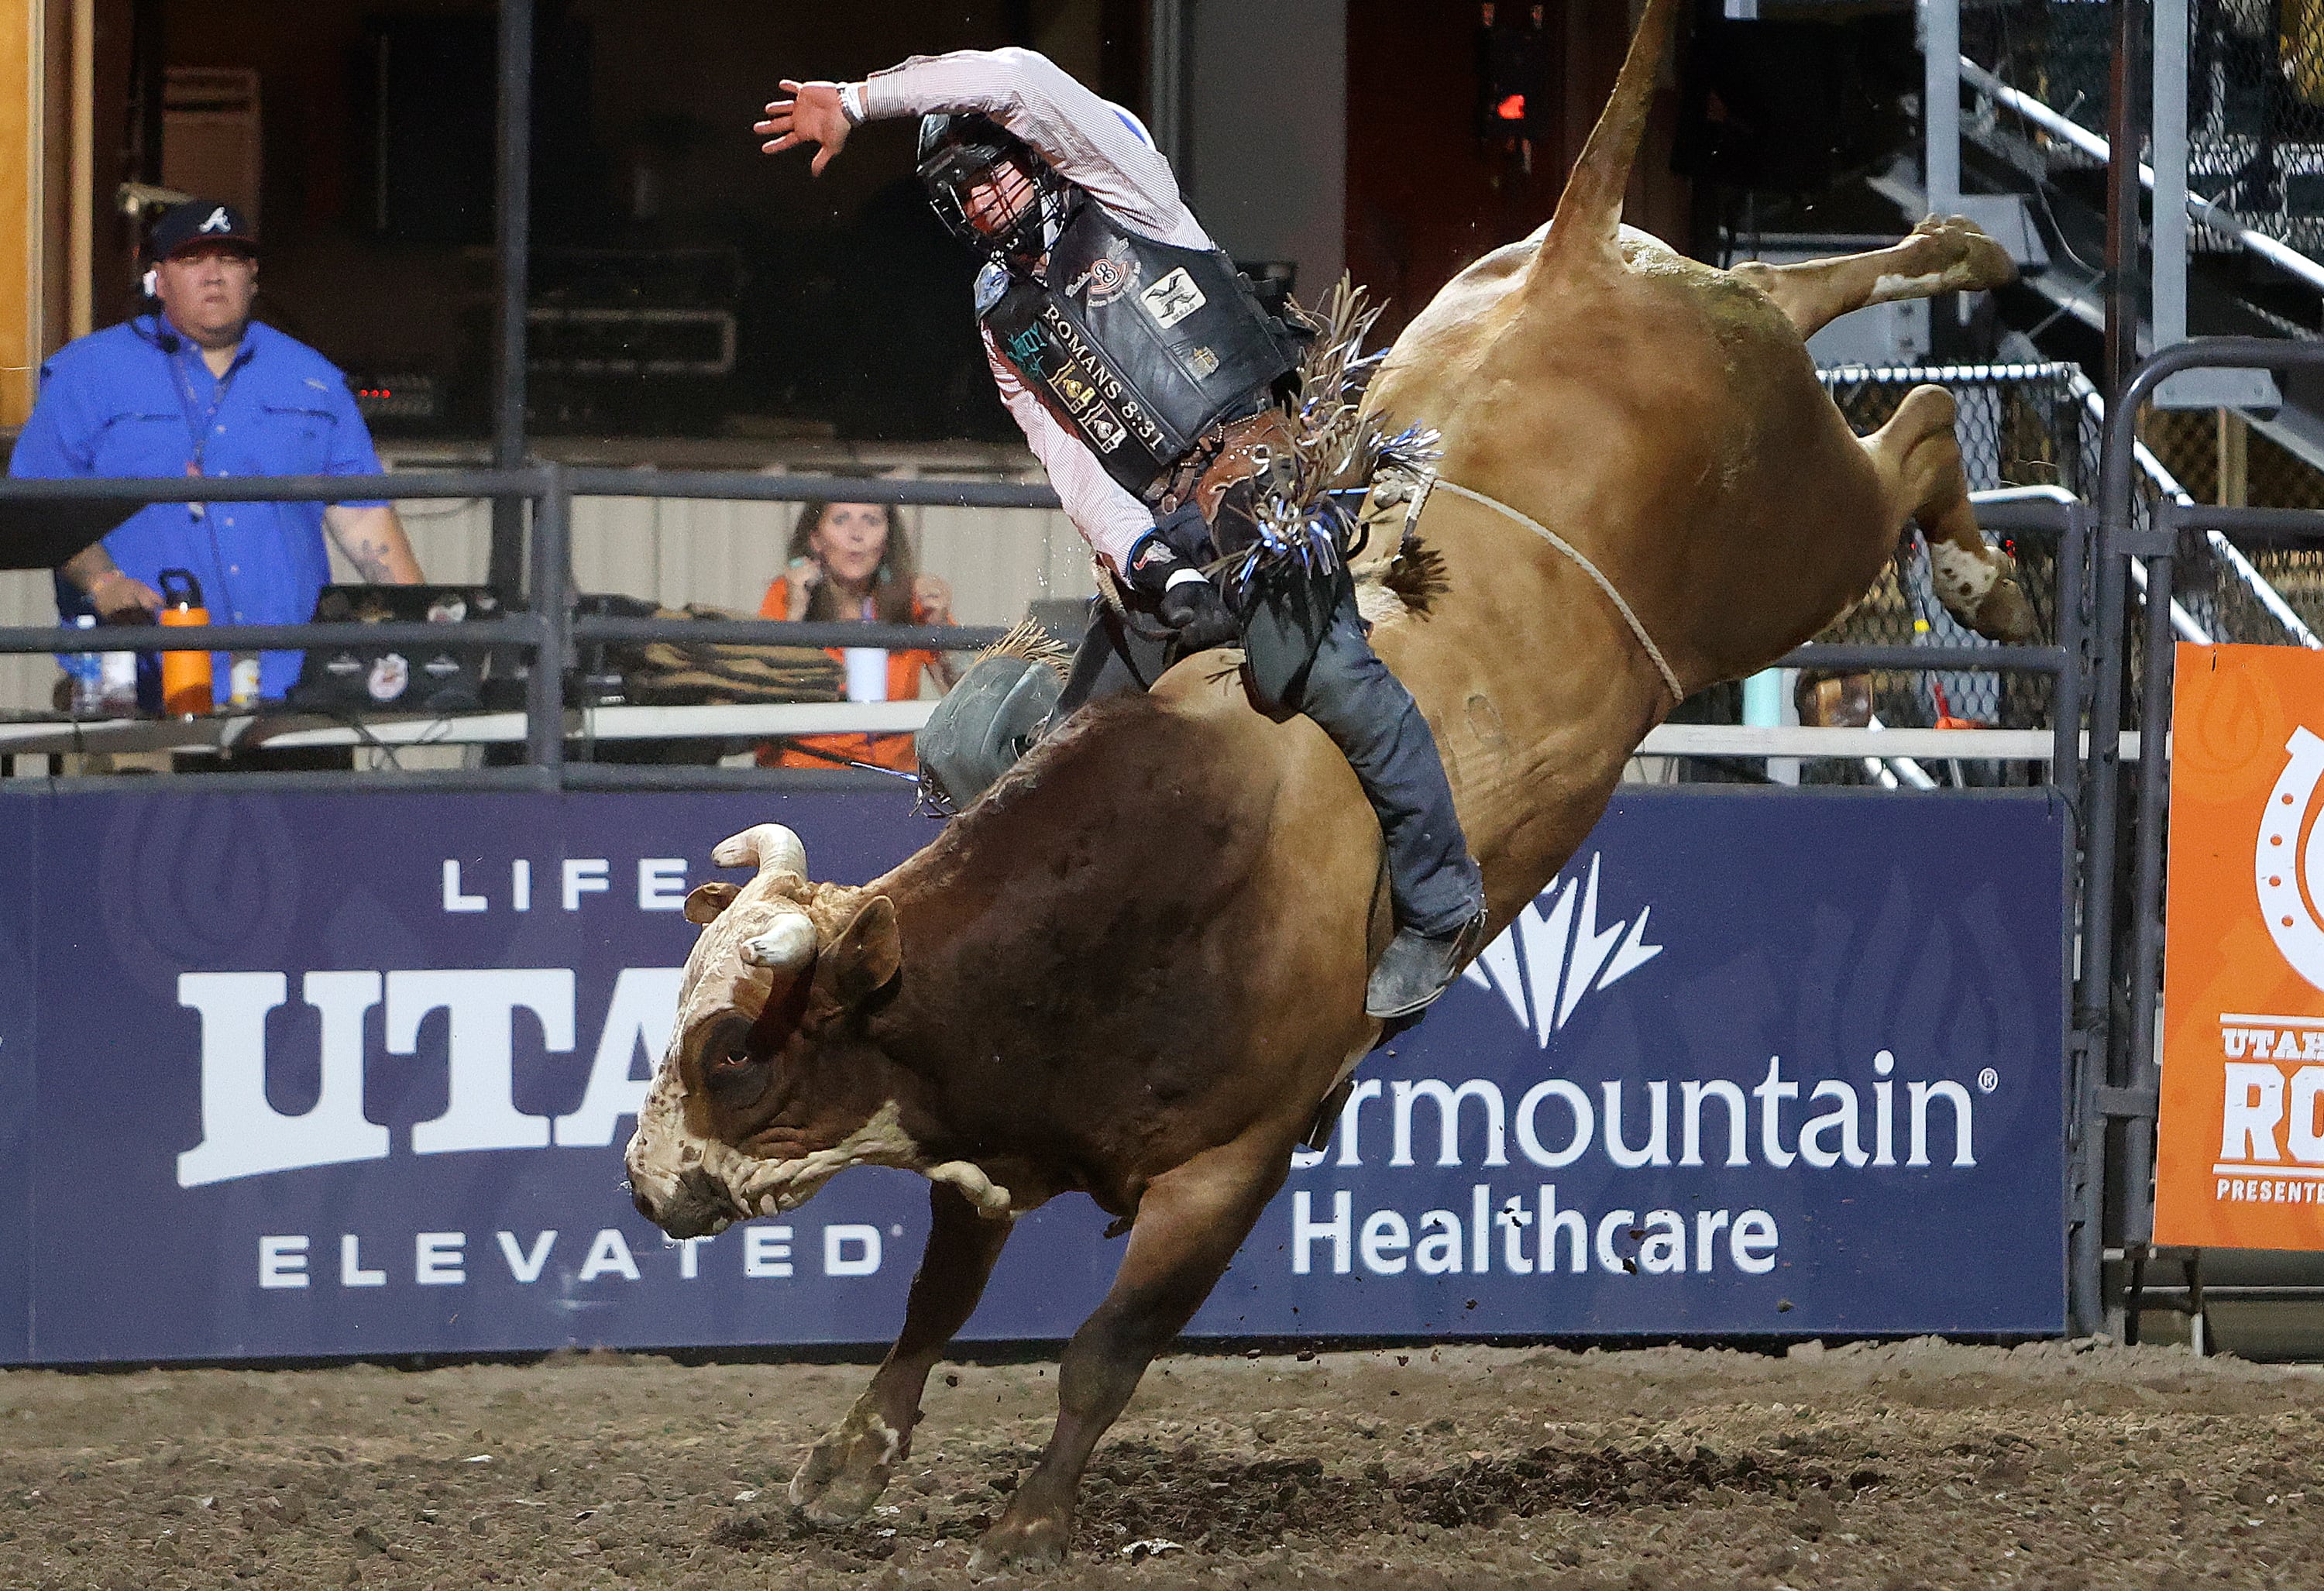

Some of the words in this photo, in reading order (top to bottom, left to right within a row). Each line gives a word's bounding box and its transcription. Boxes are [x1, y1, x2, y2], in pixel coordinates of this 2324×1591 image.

[198, 206, 231, 232] A
[1043, 304, 1123, 400] ROMANS
[1122, 401, 1165, 450] 8:31
[442, 857, 689, 912] LIFE
[177, 967, 684, 1189] UTA
[258, 1224, 882, 1289] ELEVATED
[1291, 1184, 1779, 1276] Healthcare
